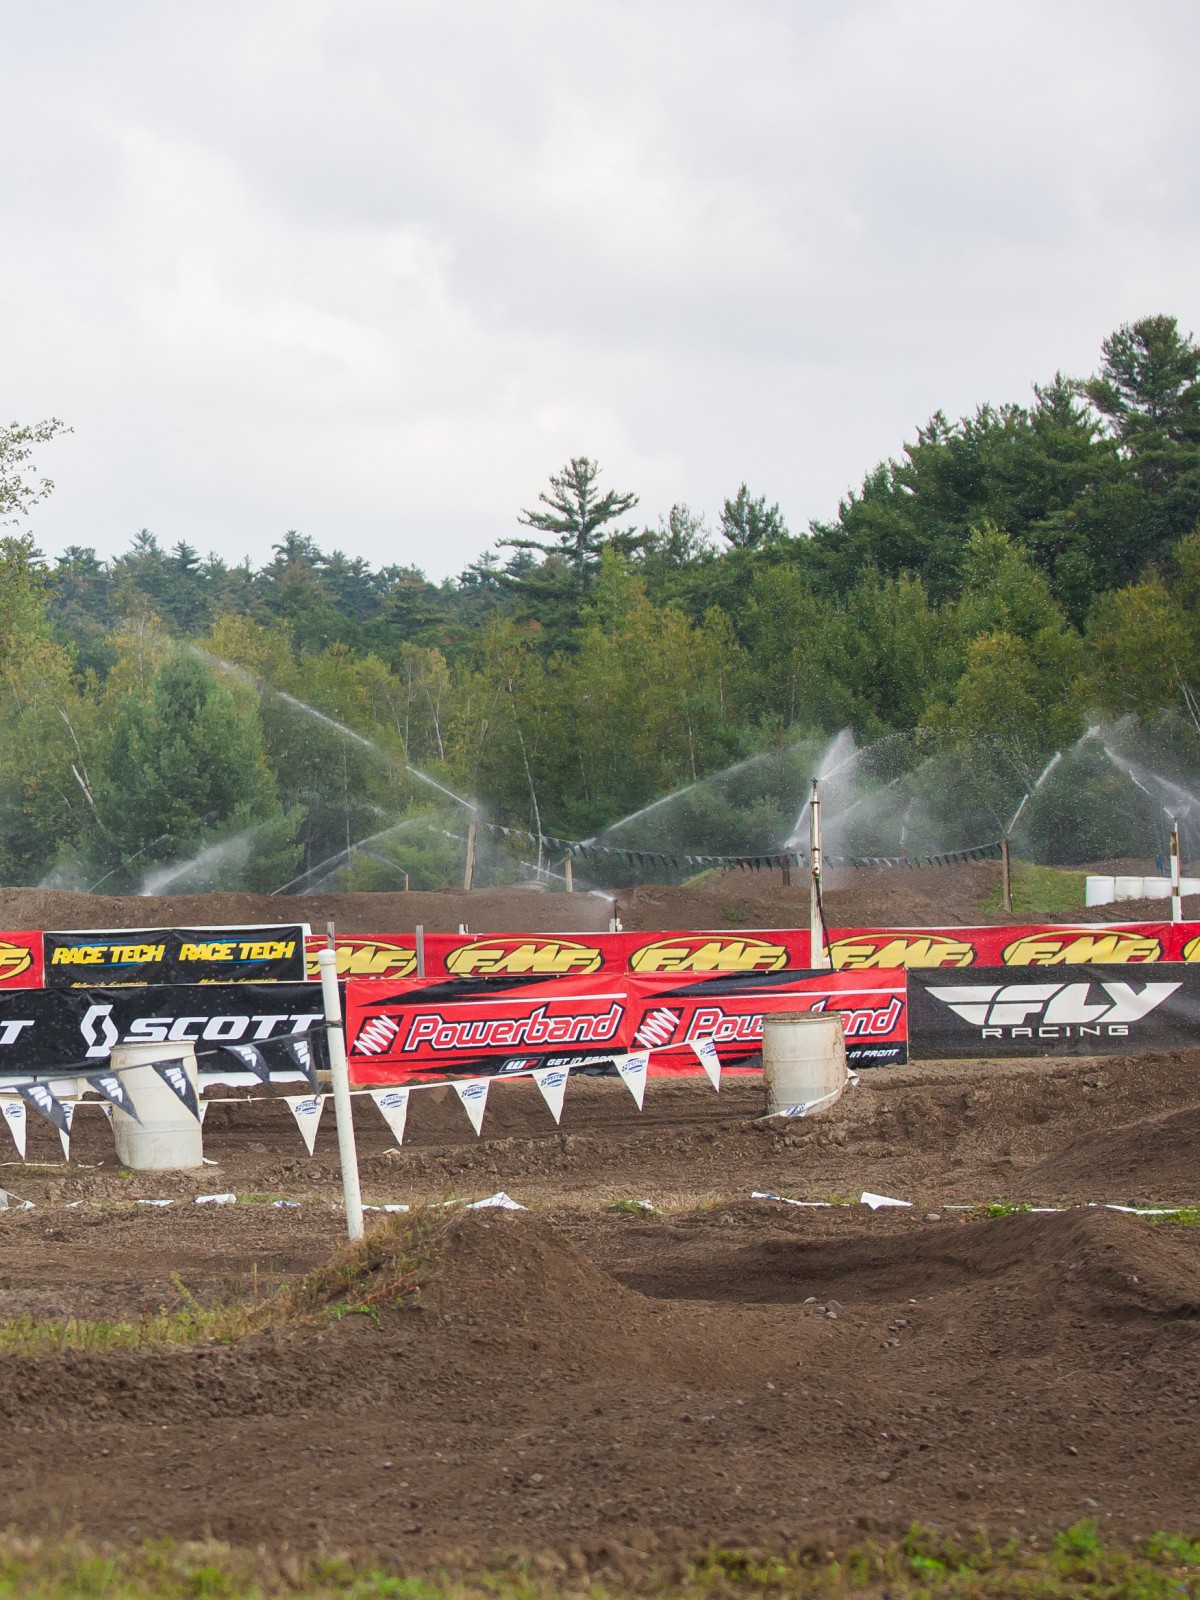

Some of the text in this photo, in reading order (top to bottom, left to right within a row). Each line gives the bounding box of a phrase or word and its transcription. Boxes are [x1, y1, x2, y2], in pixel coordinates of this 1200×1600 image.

[51, 944, 166, 965] RACE TECH
[179, 941, 296, 961] RACE TECH
[449, 944, 603, 975] FMF
[633, 941, 786, 971] FMF
[830, 938, 973, 969] FMF
[1005, 935, 1160, 966] FMF
[987, 982, 1184, 1025] FLY
[123, 1013, 324, 1042] SCOTT
[404, 1003, 624, 1051] Powerband
[981, 1024, 1129, 1039] RACING
[546, 1057, 570, 1066] GET
[862, 1048, 900, 1058] FRONT
